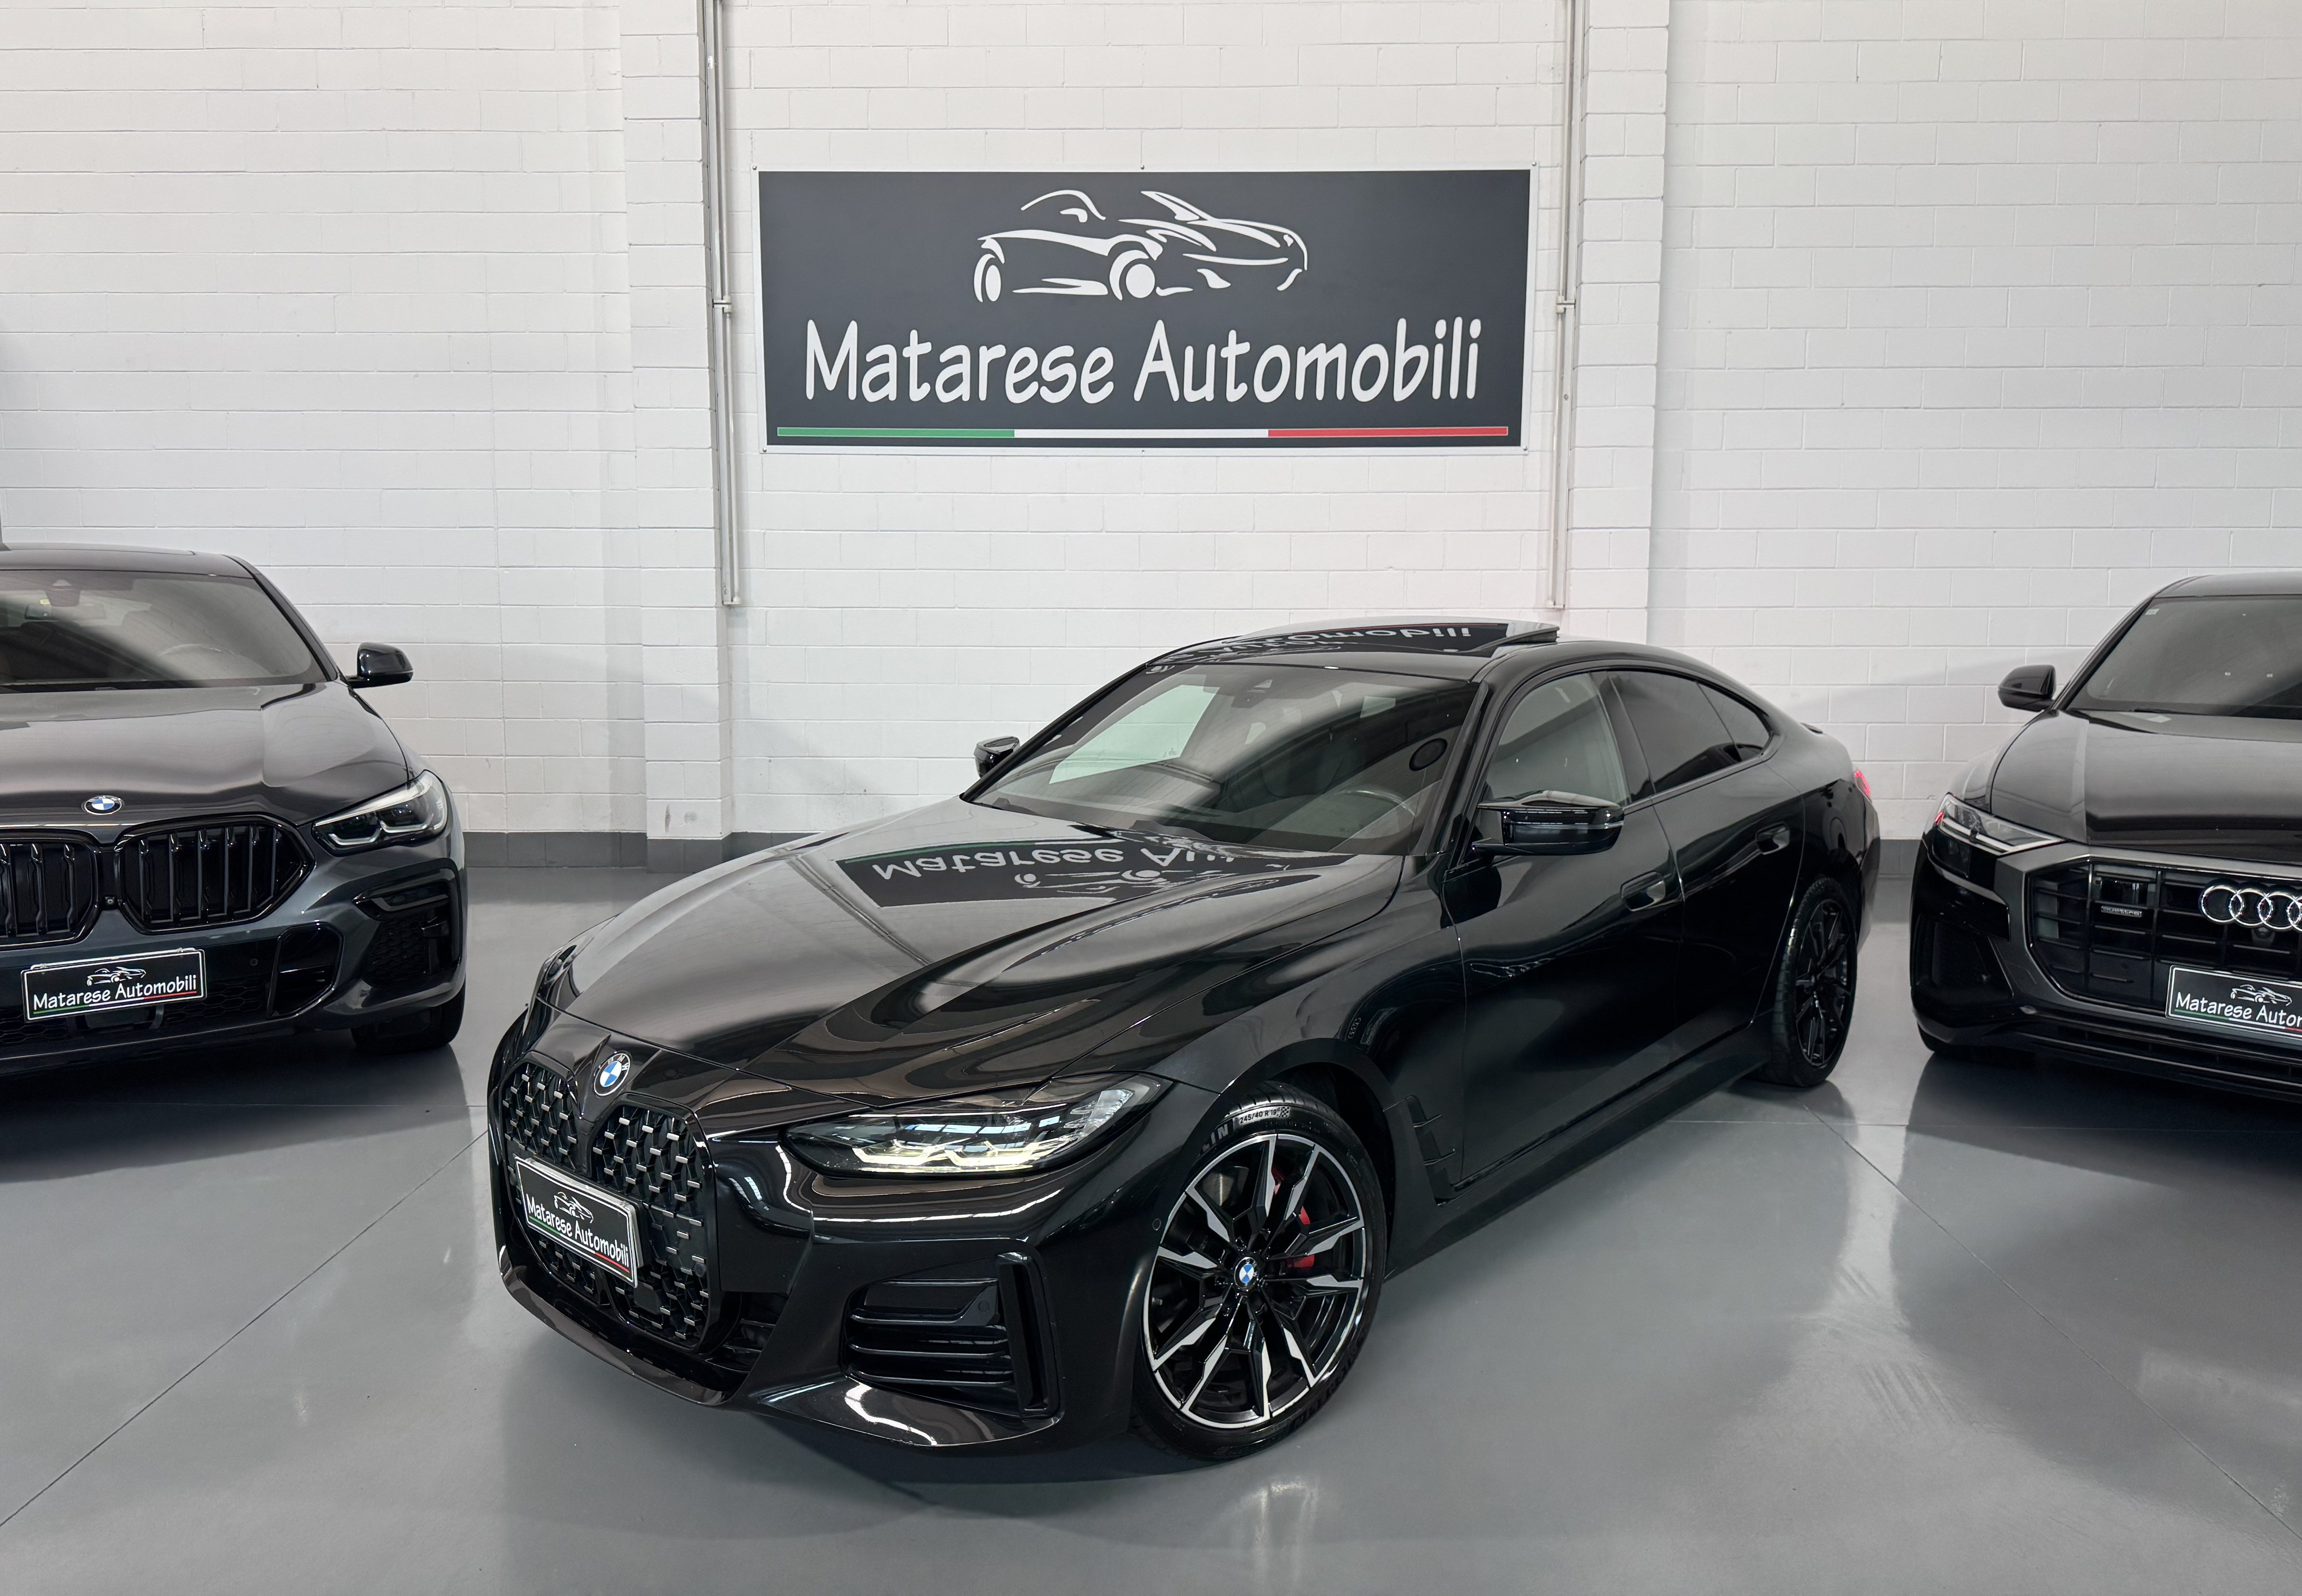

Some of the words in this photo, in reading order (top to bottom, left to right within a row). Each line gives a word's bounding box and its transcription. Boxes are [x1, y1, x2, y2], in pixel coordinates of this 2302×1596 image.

[806, 319, 1114, 404] Matarese
[1134, 316, 1481, 403] Automobili
[34, 990, 111, 1010] Matarese
[115, 975, 197, 1000] Automobili
[2175, 991, 2252, 1020] Matarese
[1239, 1111, 1263, 1124] 245/40
[526, 1193, 573, 1237] Matarese
[575, 1220, 630, 1268] Automobili
